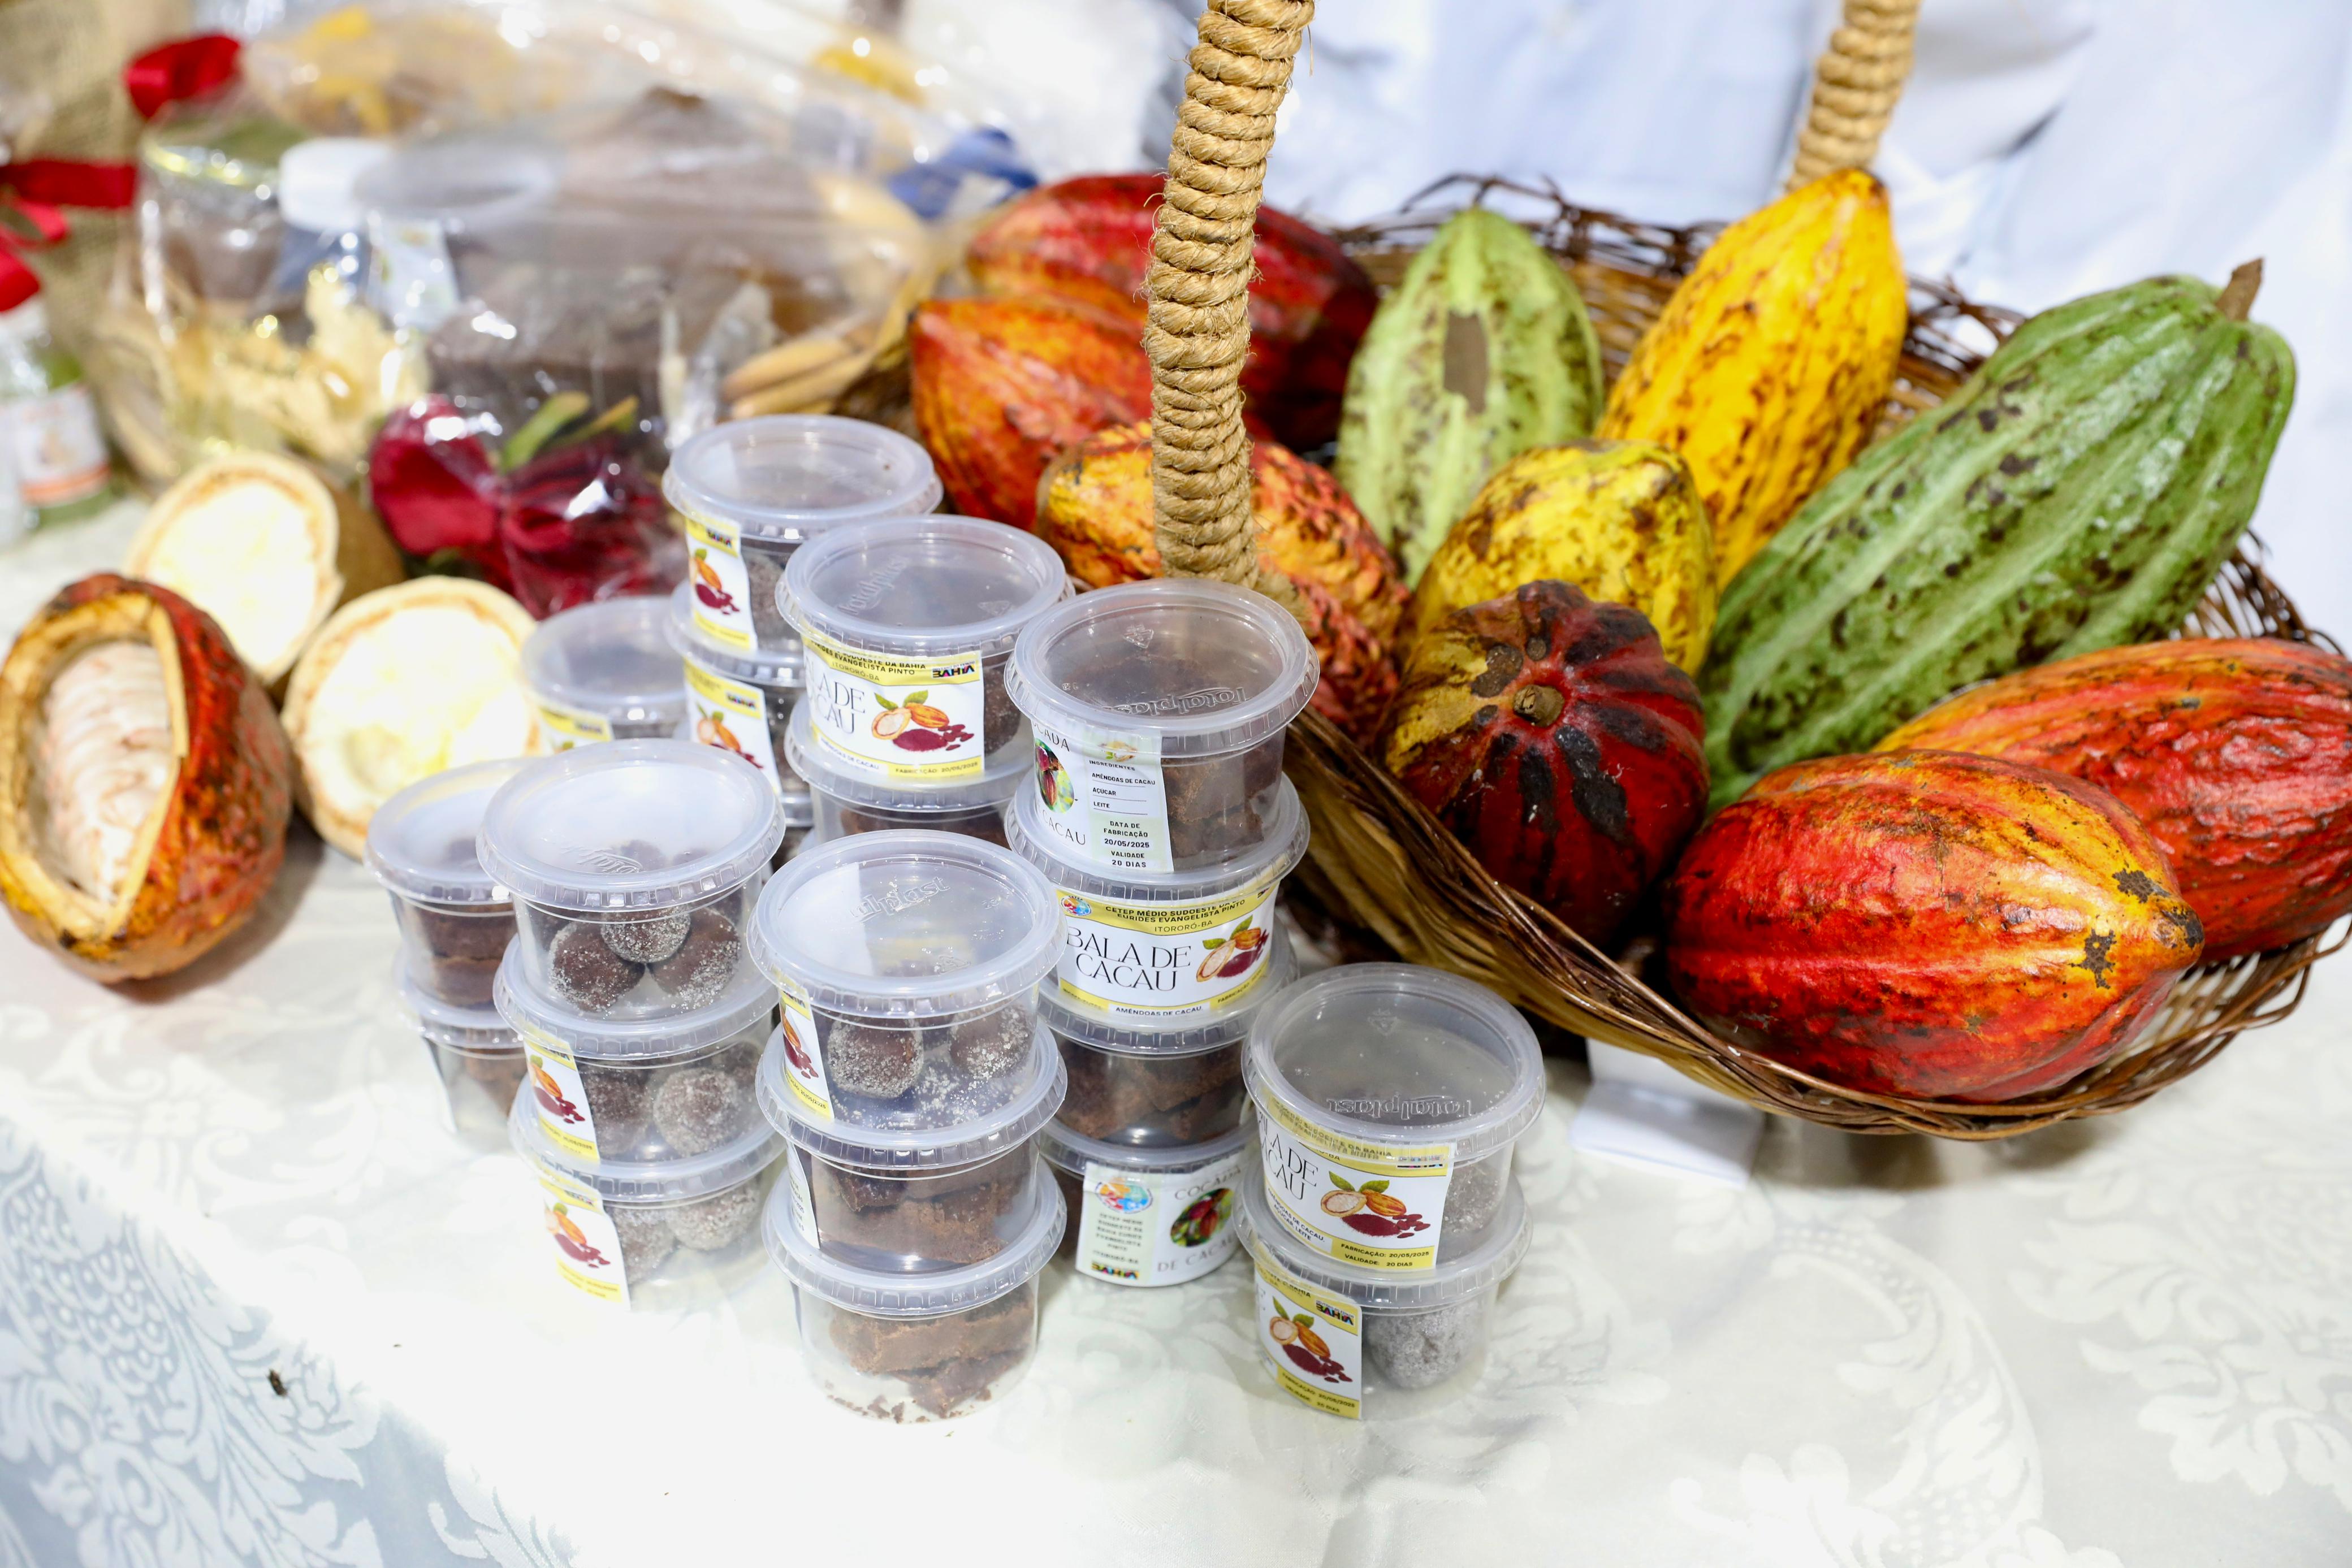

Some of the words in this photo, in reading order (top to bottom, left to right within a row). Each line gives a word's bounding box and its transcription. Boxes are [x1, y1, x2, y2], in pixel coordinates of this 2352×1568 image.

[835, 652, 886, 672] EVANGELISTA
[932, 665, 975, 678] BAHIA
[834, 681, 866, 714] DE
[1089, 760, 1135, 771] INGREDIENTES
[1092, 773, 1124, 783] AMÊNDOAS
[1043, 809, 1086, 846] CACAU
[1104, 828, 1148, 839] FABRICAÇÃO
[1105, 906, 1135, 915] CETEP
[1170, 906, 1217, 917] SUDOESTE
[1117, 913, 1156, 922] EURIDES
[1158, 911, 1220, 922] EVANGELISTA
[1222, 899, 1246, 913] PINTO
[1155, 920, 1213, 932] ITORORÓ-BA
[1066, 926, 1144, 967] BALA
[1151, 945, 1192, 968] DE
[1075, 953, 1178, 991] CACAU
[1116, 1006, 1161, 1016] AMÊNDOAS
[1287, 1146, 1318, 1187] DE
[1292, 1216, 1300, 1225] DE
[1295, 1226, 1311, 1241] LEITE
[1341, 1244, 1387, 1258] FABRICAÇÃO:
[1344, 1254, 1380, 1266] VALIDADE:
[1316, 1302, 1355, 1326] BAHIA
